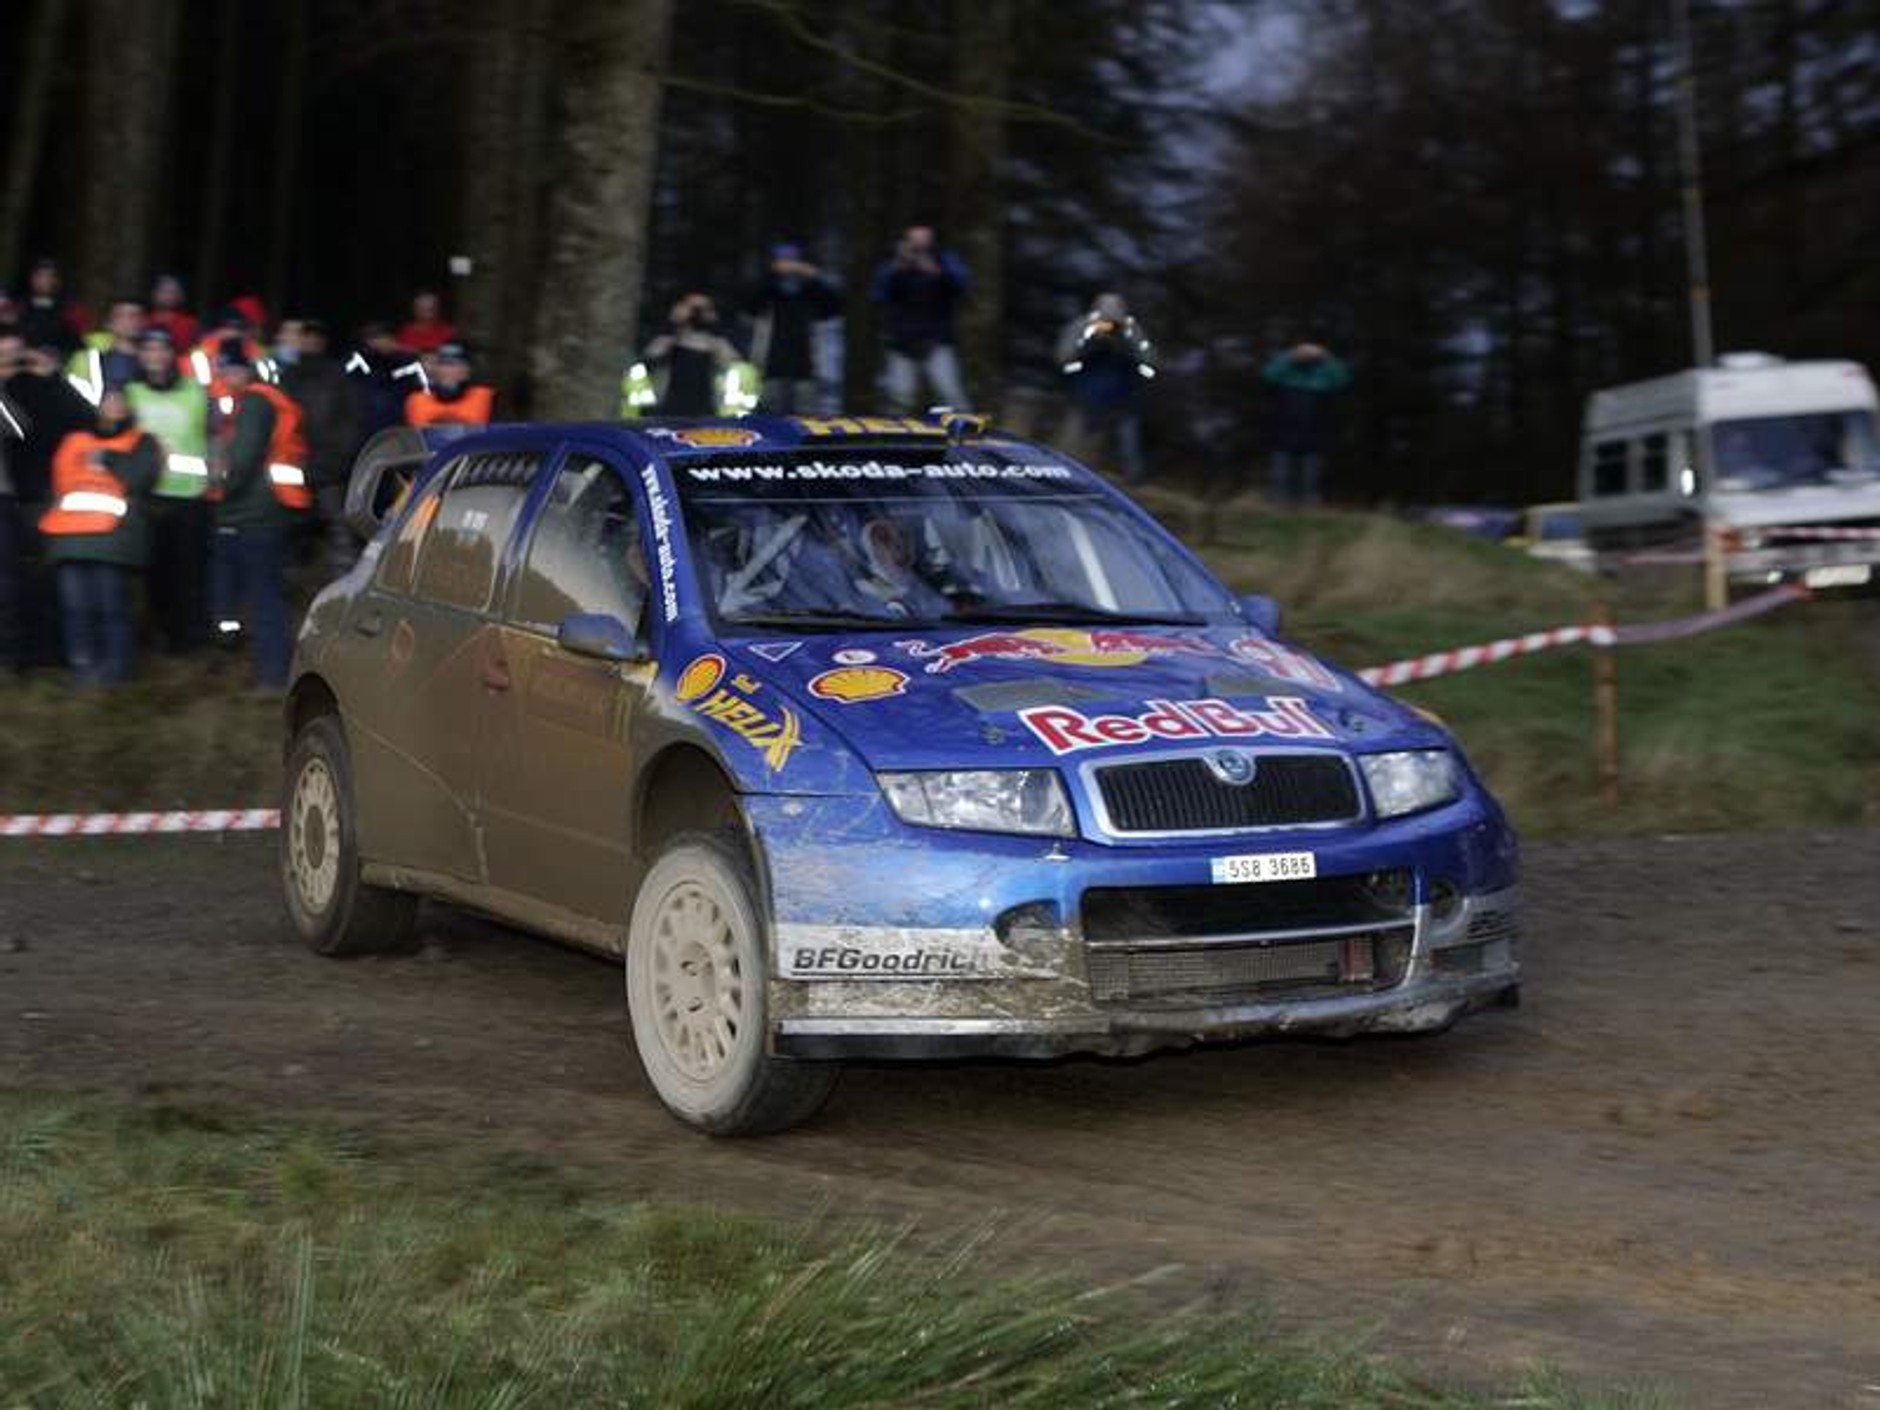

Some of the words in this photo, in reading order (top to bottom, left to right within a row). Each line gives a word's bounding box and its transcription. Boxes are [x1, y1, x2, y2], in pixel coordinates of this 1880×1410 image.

[688, 460, 1071, 482] www.skoda-auto.com
[691, 687, 804, 772] HELIX
[792, 947, 987, 970] BFGoodric
